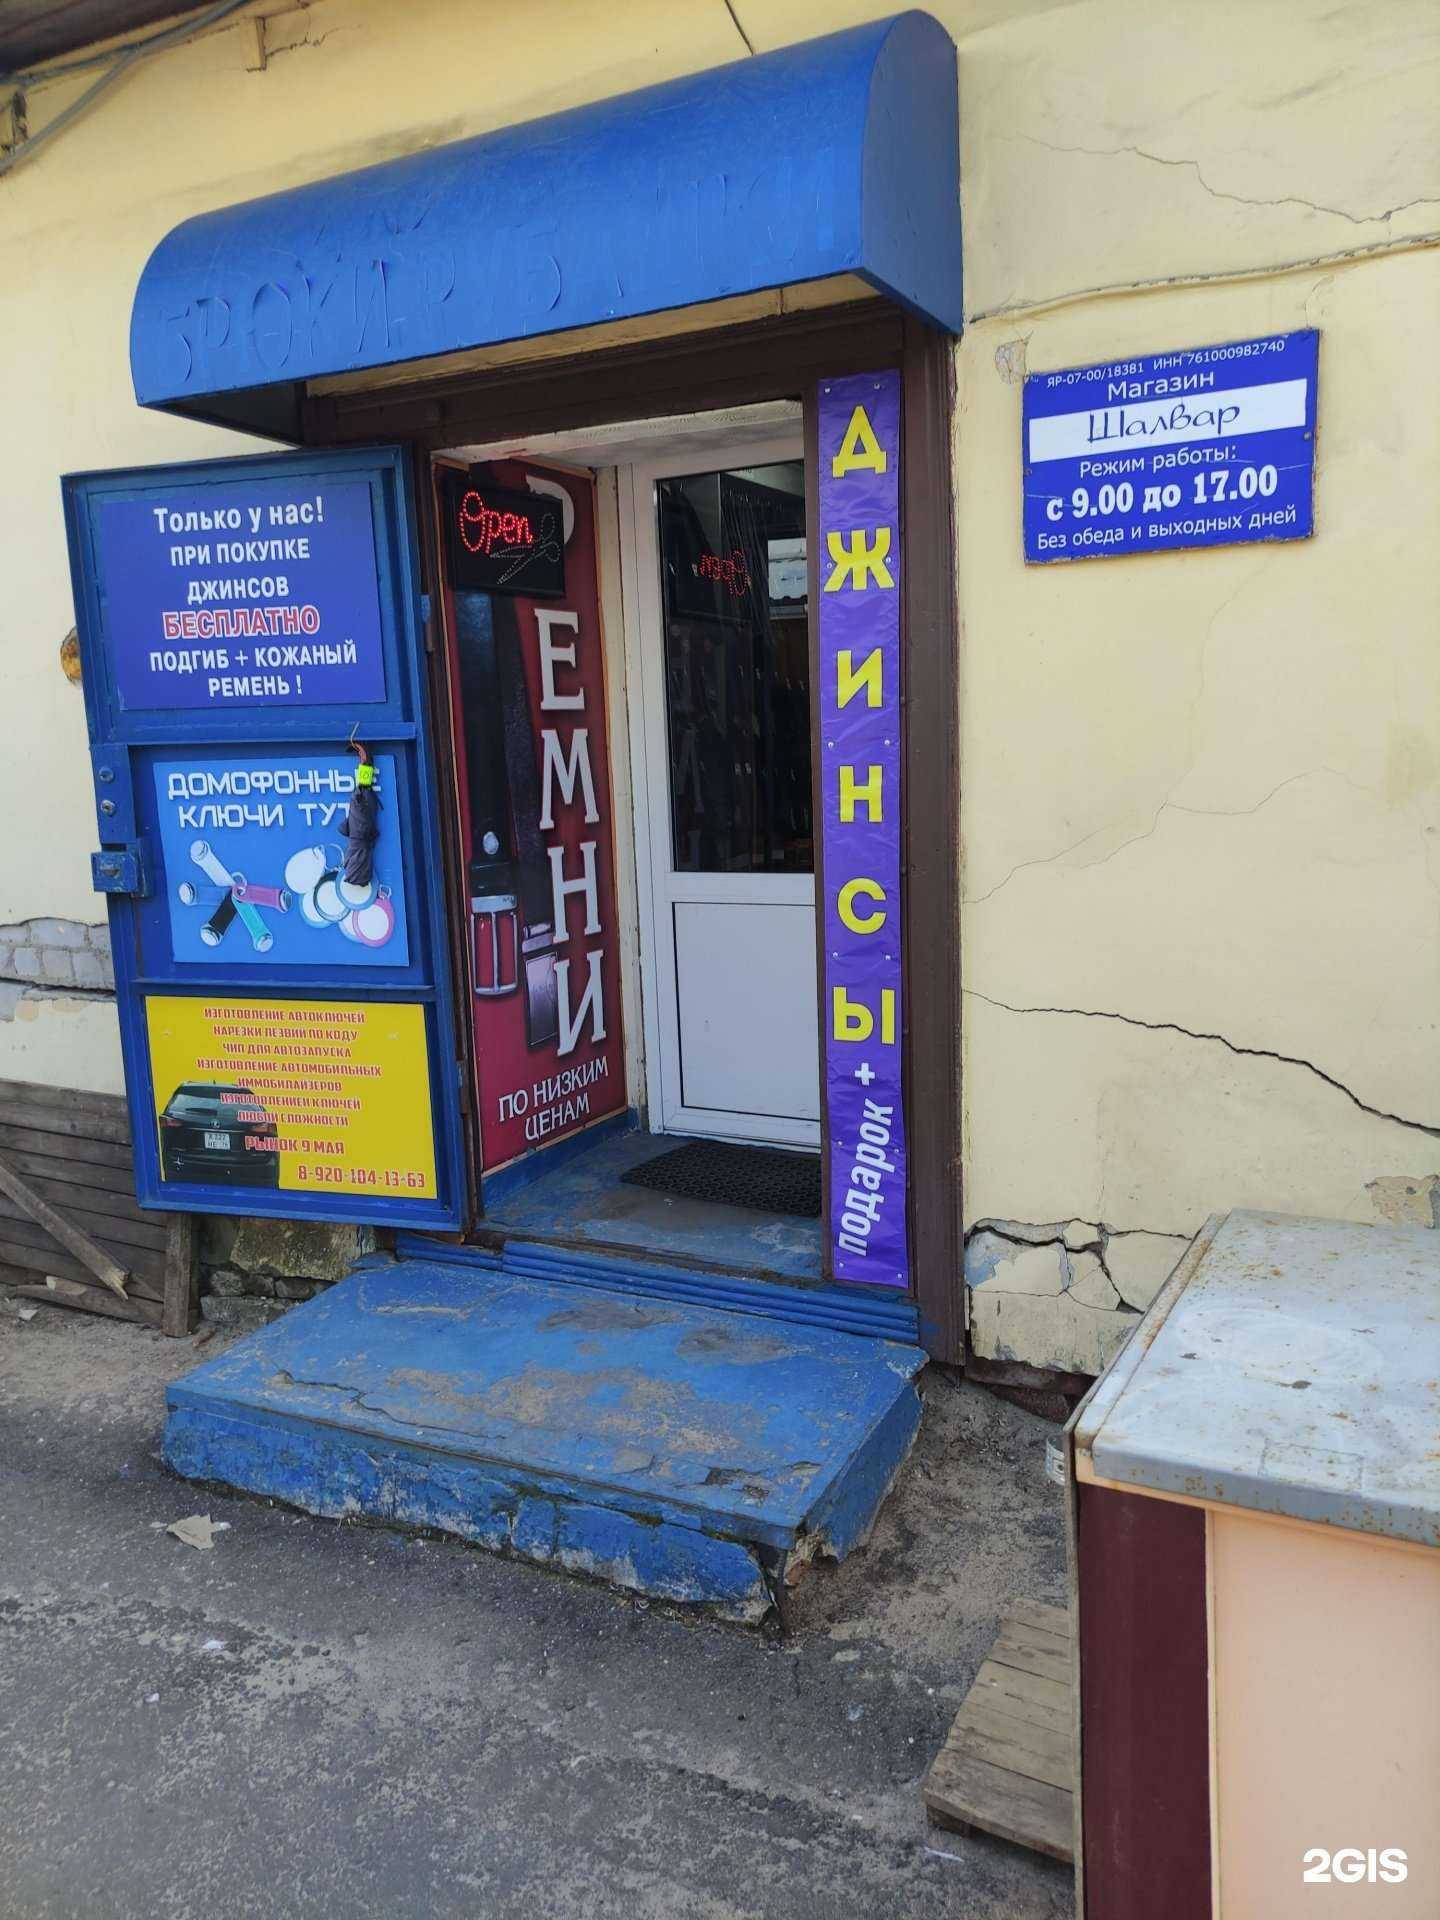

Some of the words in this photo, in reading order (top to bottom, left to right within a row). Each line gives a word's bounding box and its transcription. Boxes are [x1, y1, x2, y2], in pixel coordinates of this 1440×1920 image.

[1047, 362, 1144, 388] ЯР-07-00/18381
[1153, 355, 1183, 371] ИНН
[1187, 340, 1285, 365] 761000982740
[1108, 371, 1214, 401] Магазин
[1087, 403, 1241, 444] Шалвар
[1080, 455, 1145, 478] Режим
[1153, 444, 1237, 474] работы:
[1046, 498, 1063, 521] с
[1071, 482, 1134, 519] 9.00
[1143, 483, 1182, 514] до
[1193, 464, 1278, 504] 17.00
[153, 507, 241, 534] Только
[249, 507, 262, 534] у
[269, 496, 325, 526] нас!
[458, 491, 533, 554] Open
[1038, 528, 1067, 550] Без
[1072, 525, 1125, 547] обеда
[1131, 525, 1142, 539] и
[1149, 511, 1242, 539] выходных
[1249, 506, 1297, 530] дней
[171, 545, 211, 566] ПРИ
[217, 538, 310, 564] ПОКУПКЕ
[187, 576, 289, 604] ДЖИНСОВ
[162, 605, 320, 639] БЕСПЛАТНО
[150, 649, 229, 674] ПОДГИБ
[235, 650, 249, 667] +
[255, 639, 357, 668] КОЖАНЫЙ
[208, 676, 290, 697] РЕМЕНЬ
[824, 405, 895, 1044] ДЖИНСЫ
[178, 804, 284, 828] КЛЮЧИ
[204, 1007, 285, 1021] ИЗГОТОВЛЕНИЕ
[288, 1009, 365, 1024] АВТОКЛЮЧЕЙ
[213, 1026, 262, 1038] НАРЕЗКИ
[326, 1030, 358, 1042] КОДУ
[223, 1043, 245, 1054] ЧИП
[247, 1044, 271, 1056] ДЛЯ
[197, 1059, 279, 1072] ИЗГОТОВЛЕНИЕ
[281, 1062, 382, 1077] АВТОМОБИЛЬНЫХ
[499, 1089, 528, 1122] ПО
[533, 1055, 609, 1107] НИЗКИМ
[525, 1092, 590, 1141] ЦЕНАМ
[245, 1136, 298, 1152] РЫНОК
[301, 1138, 311, 1152] 9
[313, 1140, 344, 1154] МАЯ
[298, 1165, 426, 1188] 8-920-104-13-63
[838, 1098, 894, 1257] подарок
